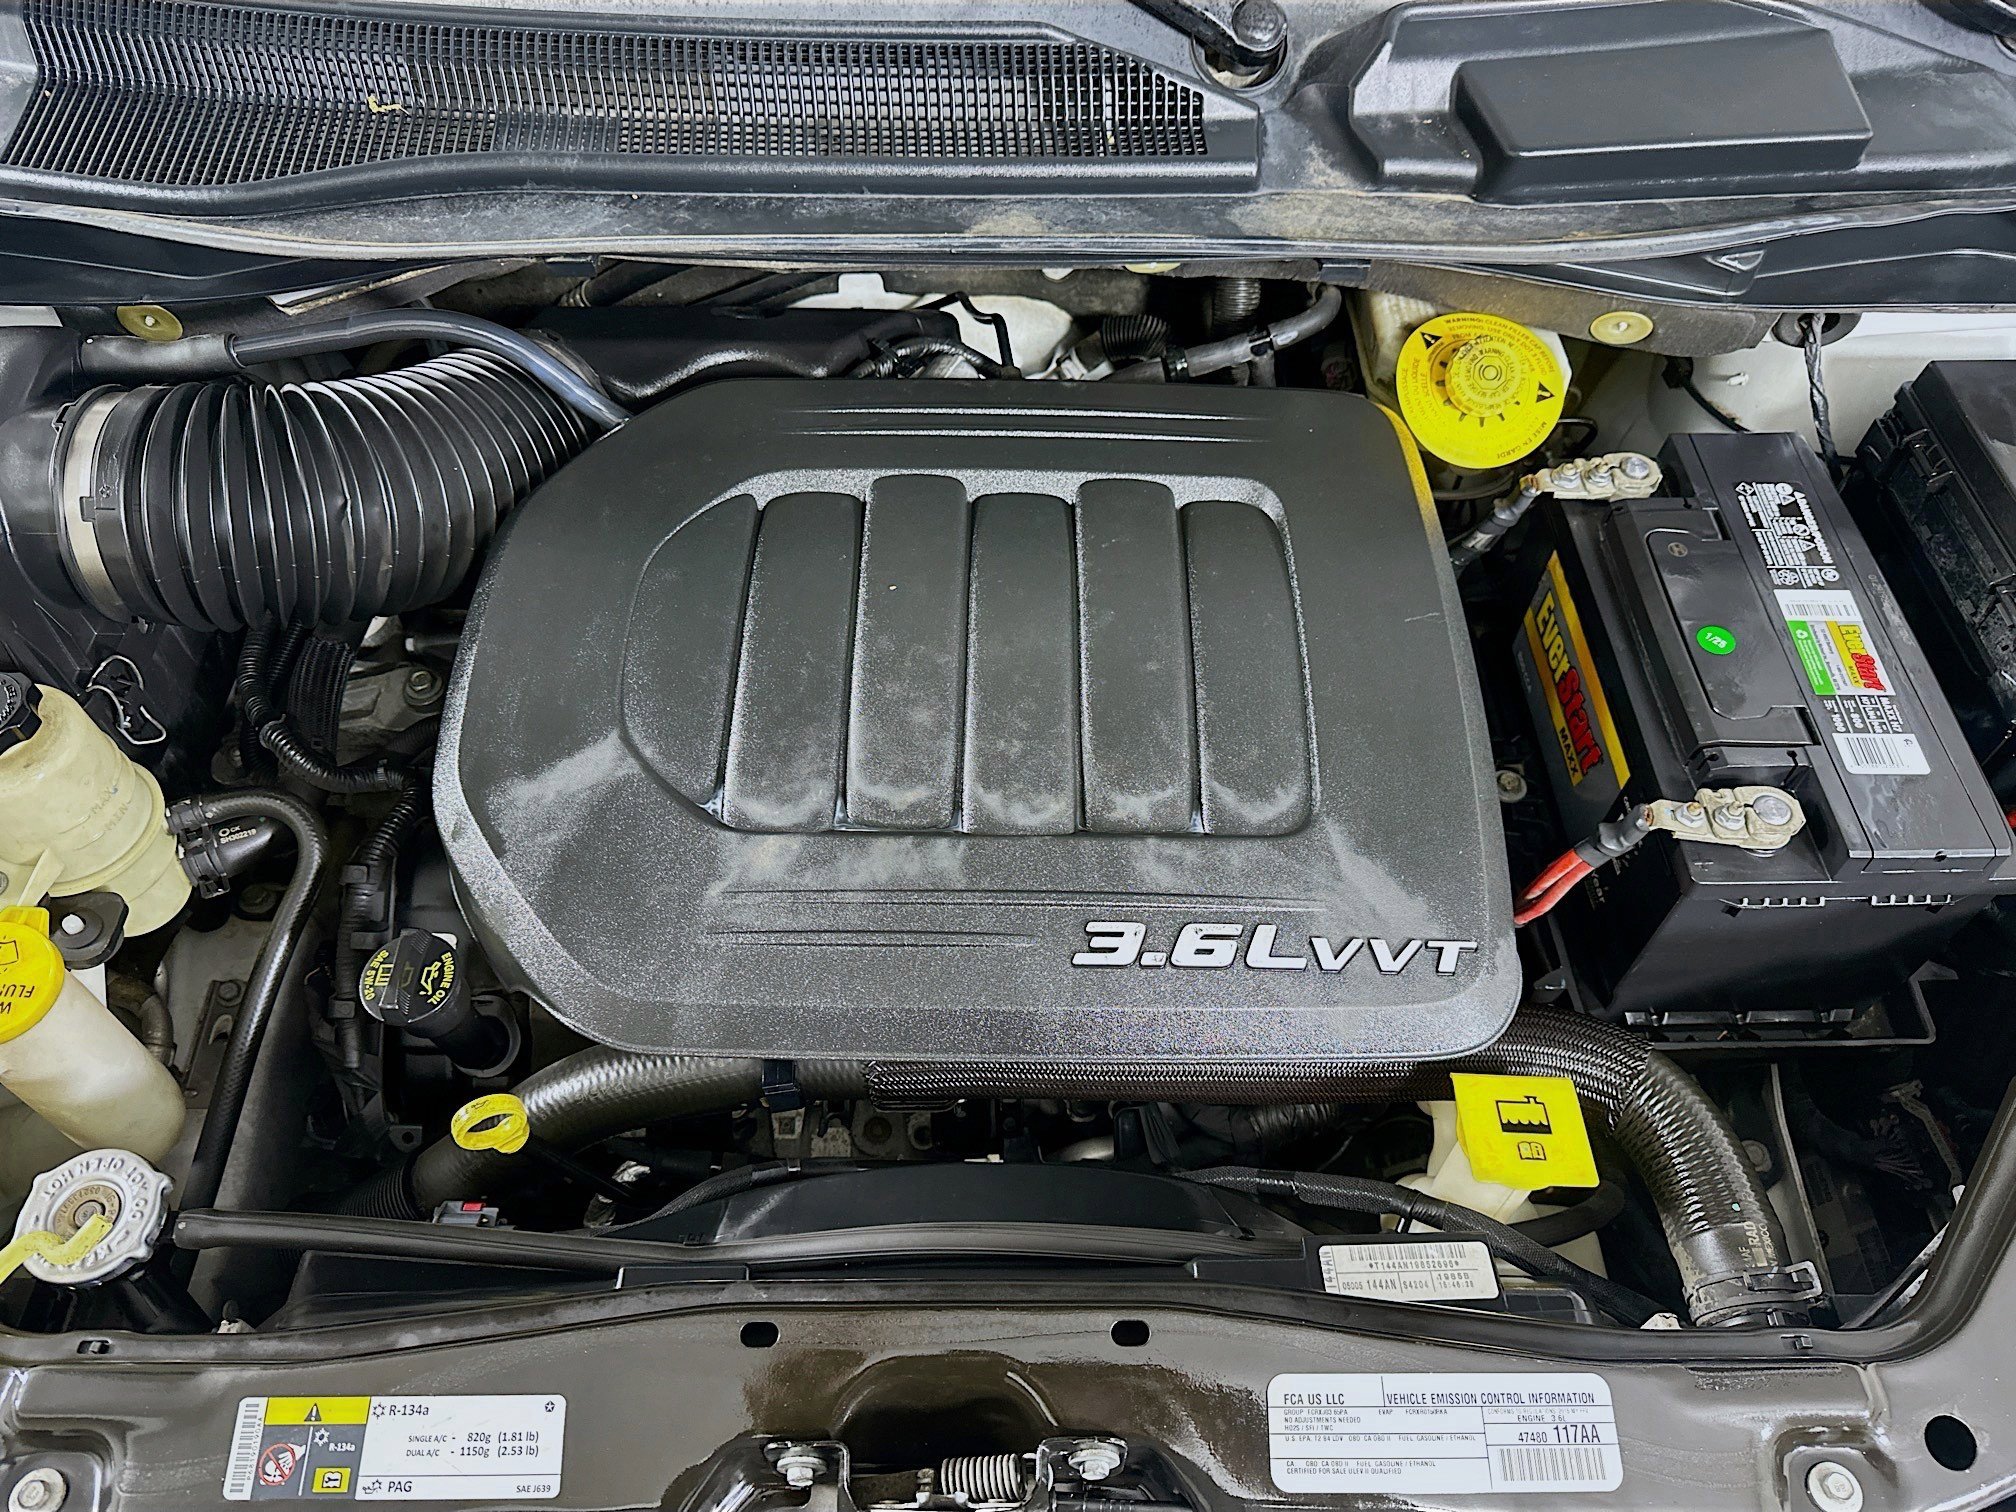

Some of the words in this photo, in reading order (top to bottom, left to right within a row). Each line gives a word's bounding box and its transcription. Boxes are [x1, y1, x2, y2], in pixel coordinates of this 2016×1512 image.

[1838, 624, 1887, 692] EverStart
[1536, 590, 1603, 777] EverStart
[1558, 727, 1579, 775] MAXX
[1071, 921, 1308, 970] 3.6L
[1309, 935, 1479, 977] VVT
[369, 949, 390, 969] SAE
[440, 951, 456, 990] ENGINE
[363, 969, 377, 1001] 5W-20
[426, 989, 446, 1005] OIL
[1743, 1220, 1761, 1246] RAD
[1366, 1279, 1397, 1290] 144AN
[1284, 1393, 1303, 1405] FCA
[1308, 1393, 1322, 1405] US
[1326, 1393, 1345, 1405] LLC
[1386, 1393, 1427, 1405] VEHICLE
[1431, 1392, 1477, 1405] EMISSION
[1481, 1392, 1526, 1404] CONTROL
[1528, 1392, 1595, 1404] INFORMATION
[389, 1404, 429, 1416] R-134a
[408, 1434, 432, 1443] SINGLE
[434, 1434, 448, 1443] A/C
[466, 1432, 491, 1444] 820g
[498, 1431, 523, 1443] (1.81
[525, 1430, 539, 1443] lb)
[1518, 1432, 1548, 1443] 47480
[1553, 1424, 1601, 1443] 117AA
[328, 1442, 356, 1452] R-134a
[406, 1449, 425, 1458] DUAL
[426, 1449, 440, 1458] A/C
[459, 1446, 490, 1459] 1150g
[497, 1445, 522, 1458] (2.53
[525, 1444, 539, 1457] lb)
[1286, 1467, 1317, 1475] CERTIFIED
[1319, 1467, 1331, 1475] FOR
[1331, 1467, 1347, 1475] SALE
[1370, 1467, 1402, 1475] QUALIFIED
[387, 1480, 413, 1493] PAG
[516, 1484, 532, 1493] SAE
[532, 1484, 551, 1494] J639
